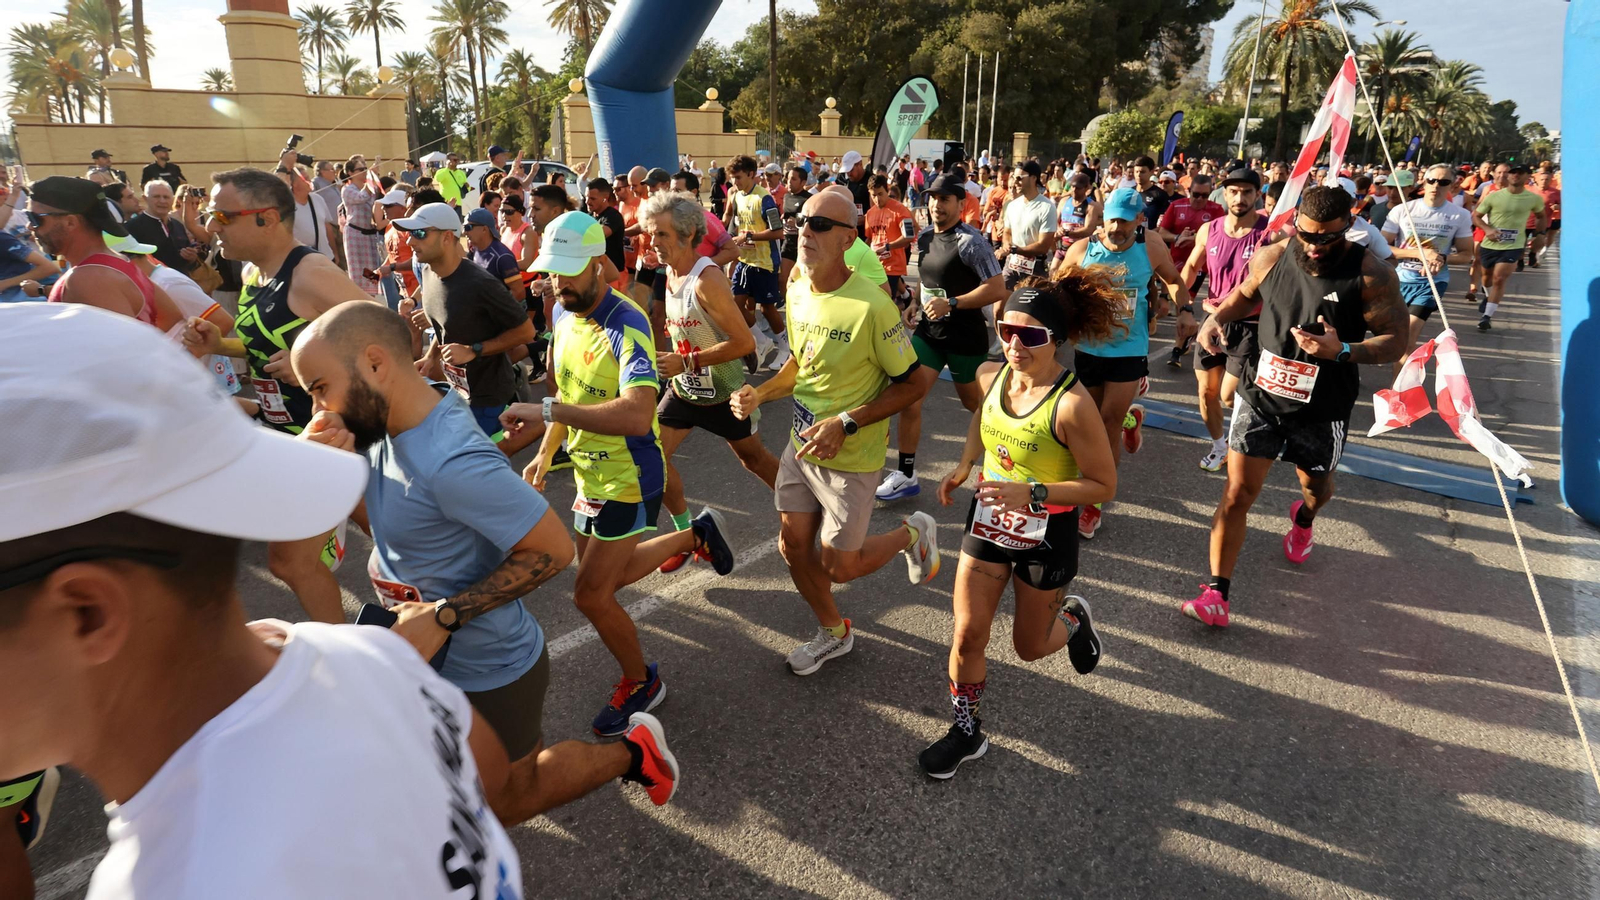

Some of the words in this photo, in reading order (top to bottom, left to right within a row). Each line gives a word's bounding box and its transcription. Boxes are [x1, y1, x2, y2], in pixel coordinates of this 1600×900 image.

[564, 368, 607, 397] RUNNER'S
[681, 375, 701, 388] 685
[1269, 368, 1299, 387] 335
[990, 509, 1028, 535] 552
[814, 641, 844, 664] BROOKS
